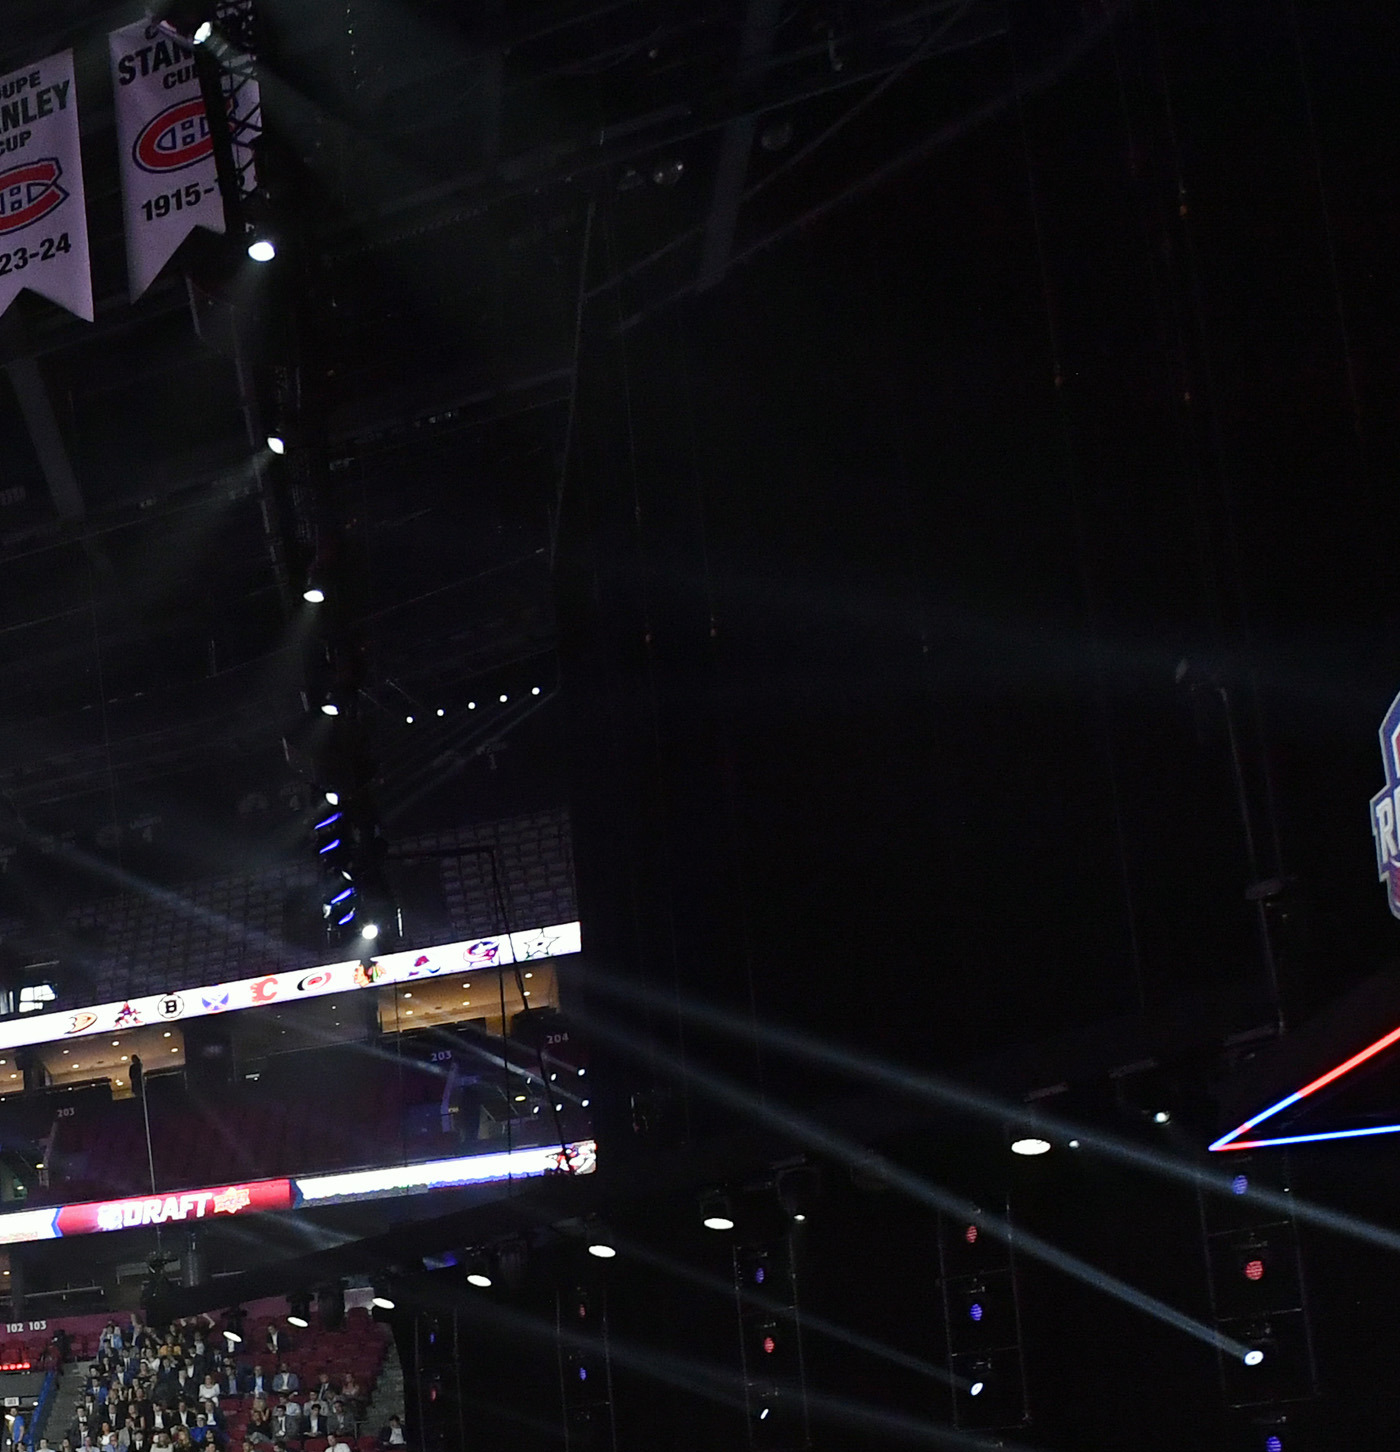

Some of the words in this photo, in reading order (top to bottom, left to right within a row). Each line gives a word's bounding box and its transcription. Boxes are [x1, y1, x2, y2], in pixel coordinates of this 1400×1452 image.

[546, 1032, 569, 1044] 204
[431, 1050, 452, 1062] 203
[57, 1107, 75, 1117] 203
[126, 1192, 213, 1229] DRAFT
[6, 1323, 24, 1334] 102
[28, 1320, 47, 1331] 103
